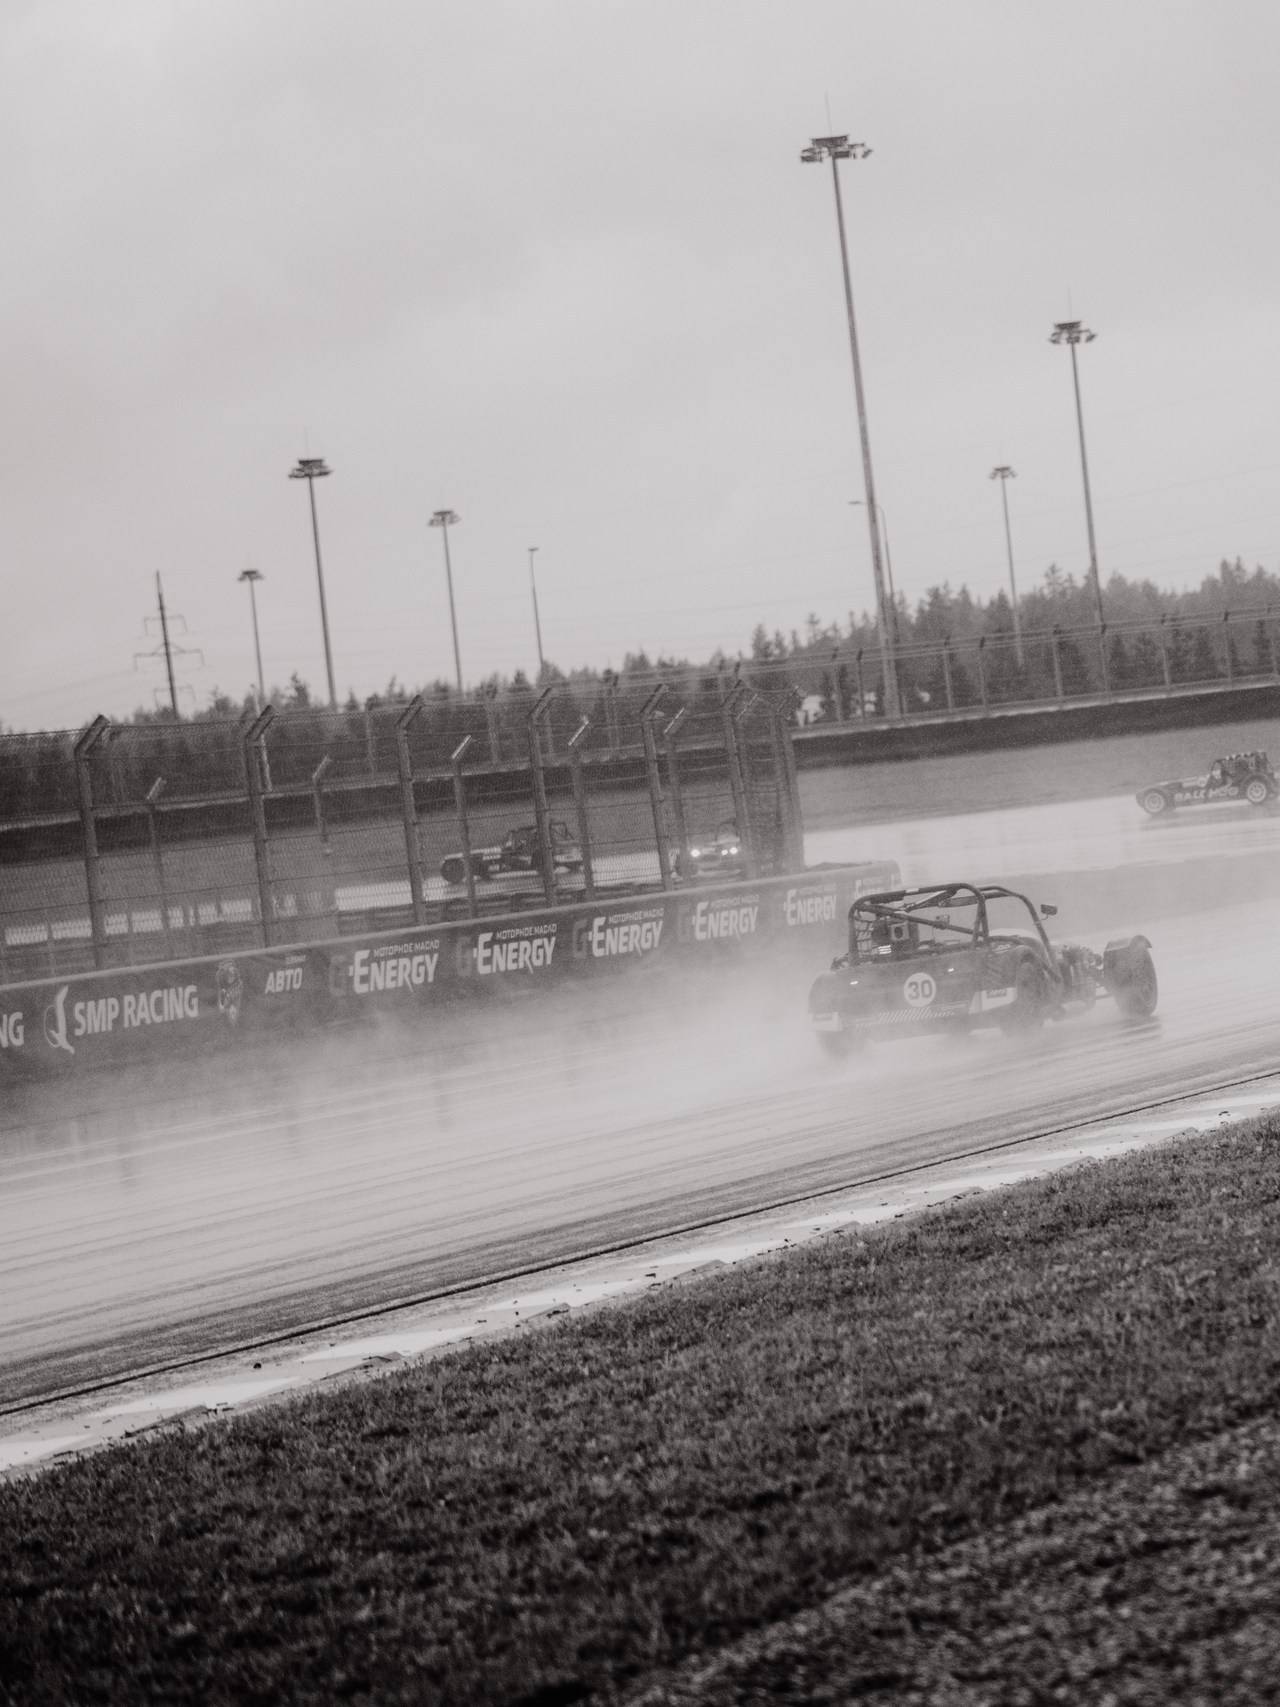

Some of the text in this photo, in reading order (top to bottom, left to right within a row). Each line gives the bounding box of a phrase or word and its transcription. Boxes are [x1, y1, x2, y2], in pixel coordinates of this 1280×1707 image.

[495, 923, 557, 940] МОТОРНОЕ МАСЛО
[373, 939, 440, 958] МОТОРНОЕ МАСЛО
[907, 979, 934, 1000] 30
[74, 997, 119, 1036] SMP
[123, 984, 199, 1028] RACING
